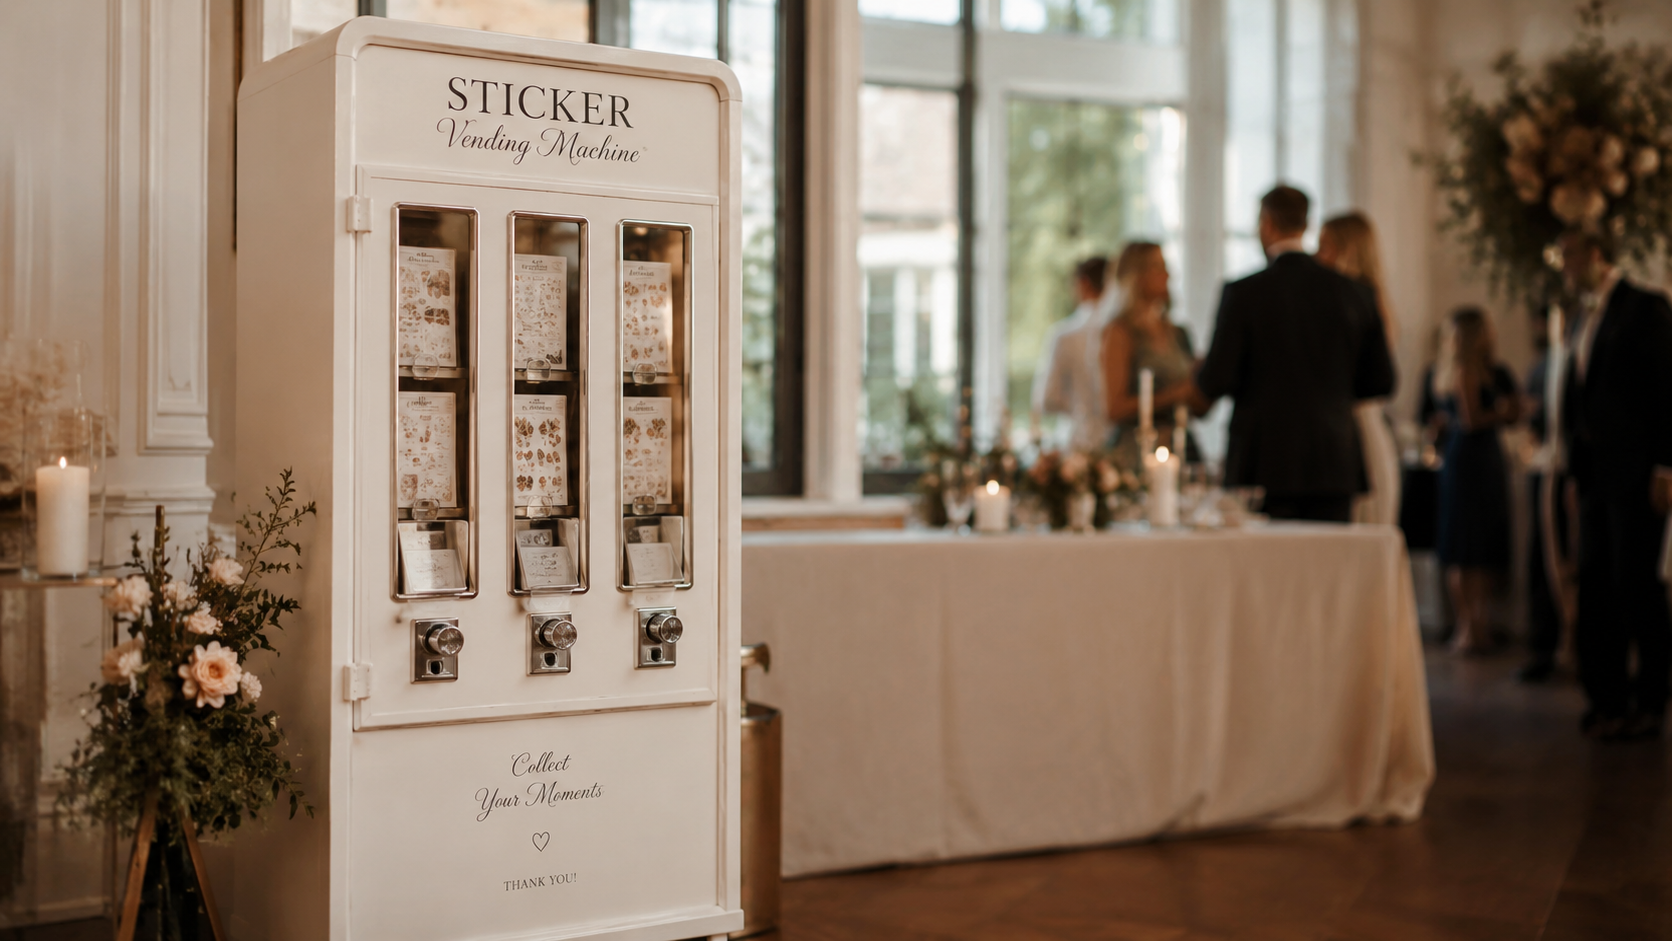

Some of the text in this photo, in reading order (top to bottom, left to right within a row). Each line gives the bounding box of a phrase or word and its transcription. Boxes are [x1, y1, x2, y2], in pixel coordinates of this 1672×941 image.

[448, 76, 634, 128] STICKER
[436, 117, 641, 166] Vending Machine
[511, 751, 572, 777] Collect
[474, 781, 603, 822] Your Moments
[504, 873, 577, 891] THANK YOU!
